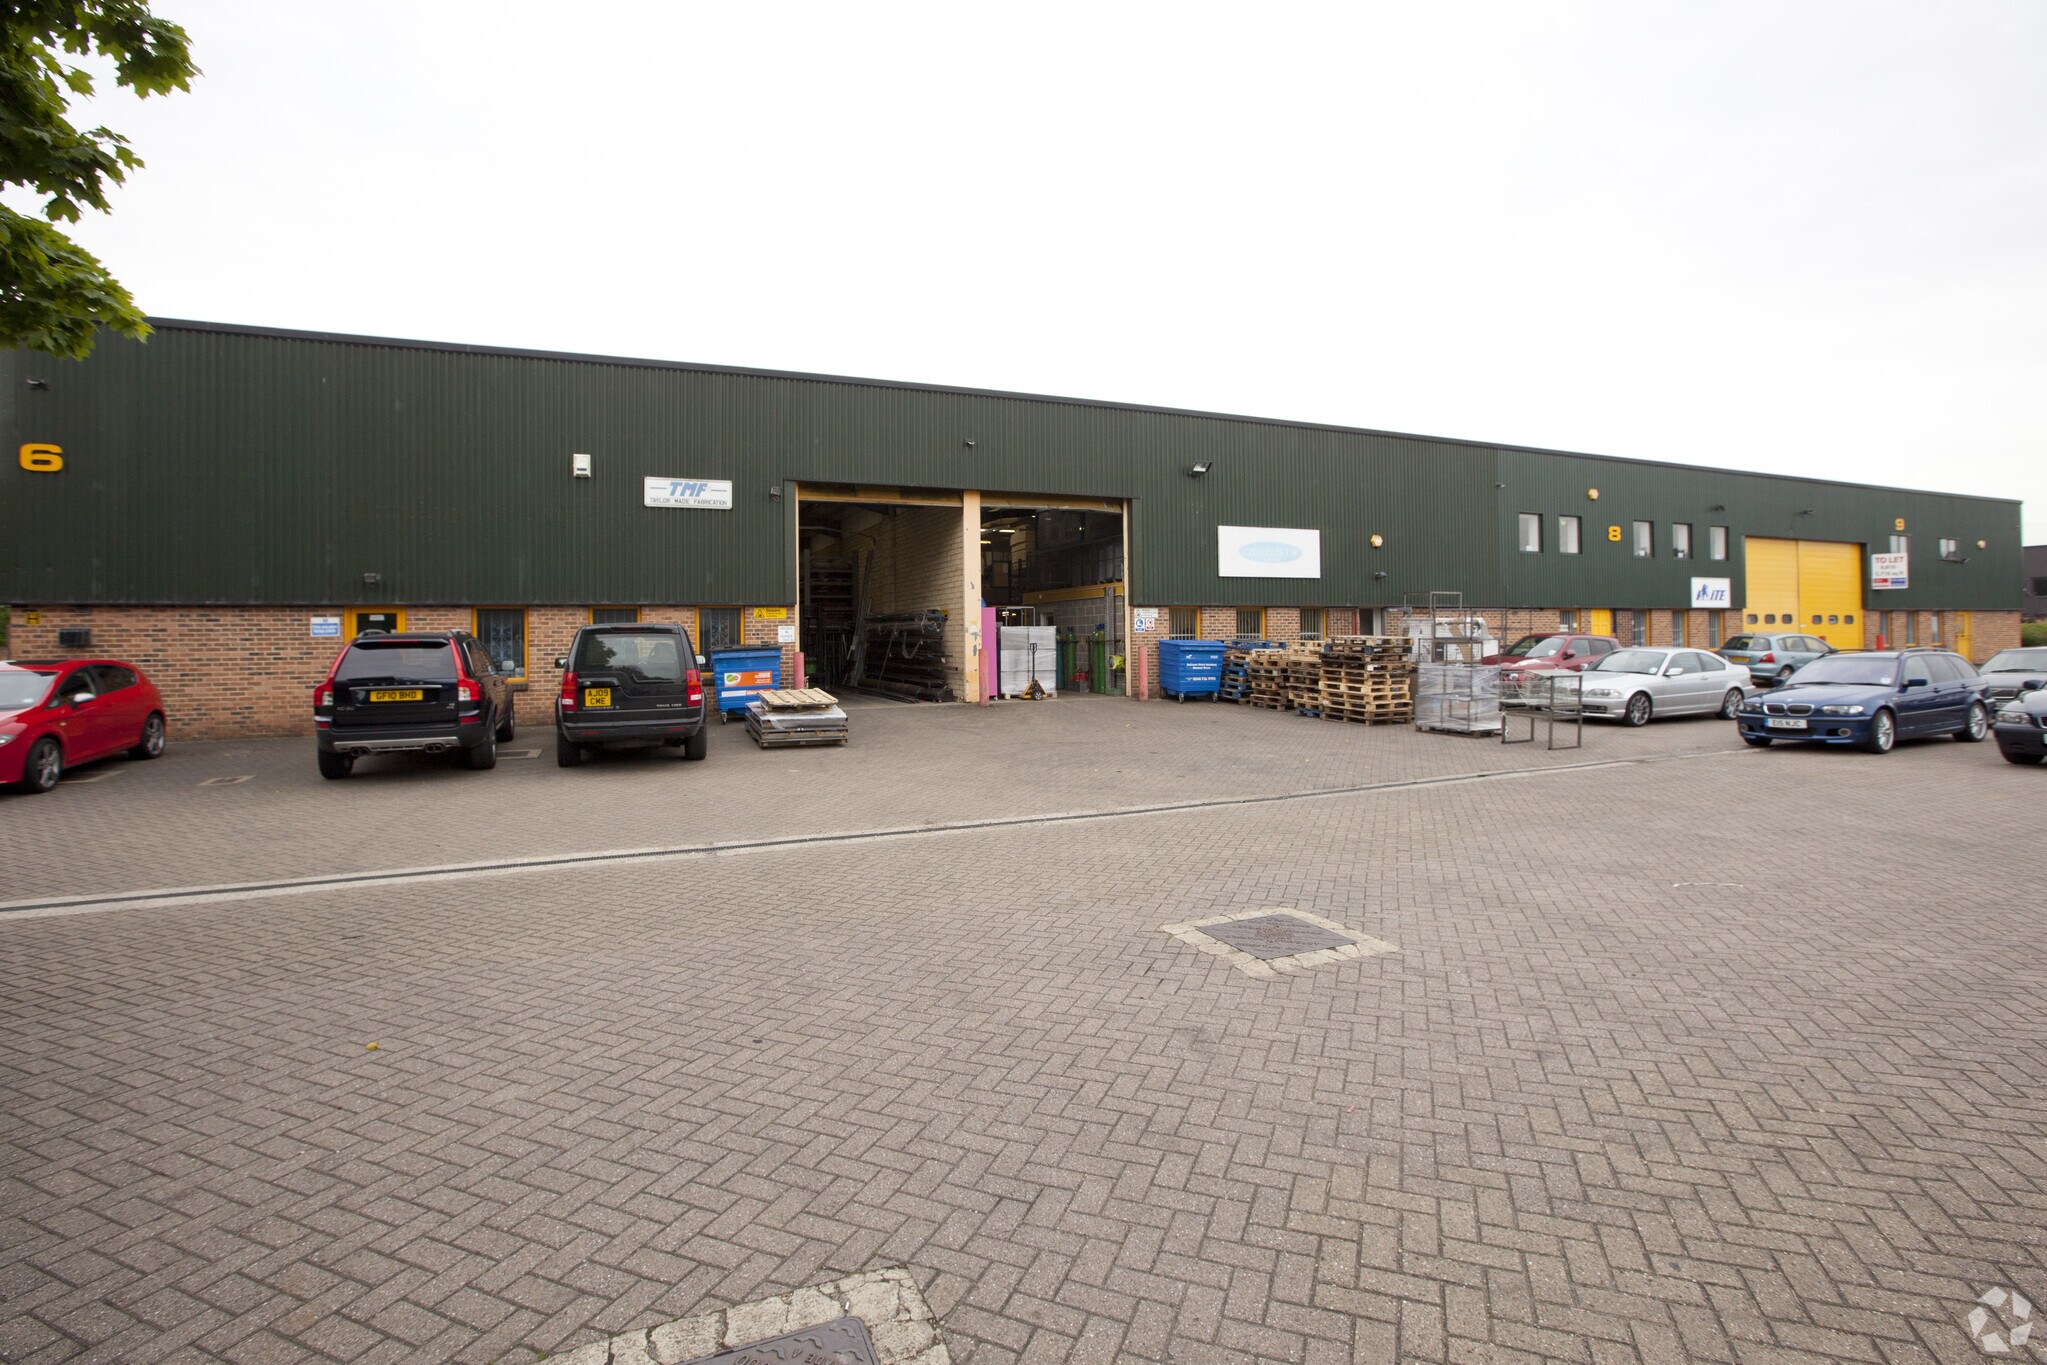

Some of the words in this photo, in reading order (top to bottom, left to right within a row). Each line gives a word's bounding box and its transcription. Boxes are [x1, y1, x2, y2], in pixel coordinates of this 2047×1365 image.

[19, 443, 64, 472] 6
[669, 481, 709, 498] TMF
[1895, 518, 1905, 531] 9
[1608, 525, 1622, 542] 8
[376, 691, 397, 700] GF10
[399, 690, 417, 699] BHD
[587, 690, 609, 698] AJ09
